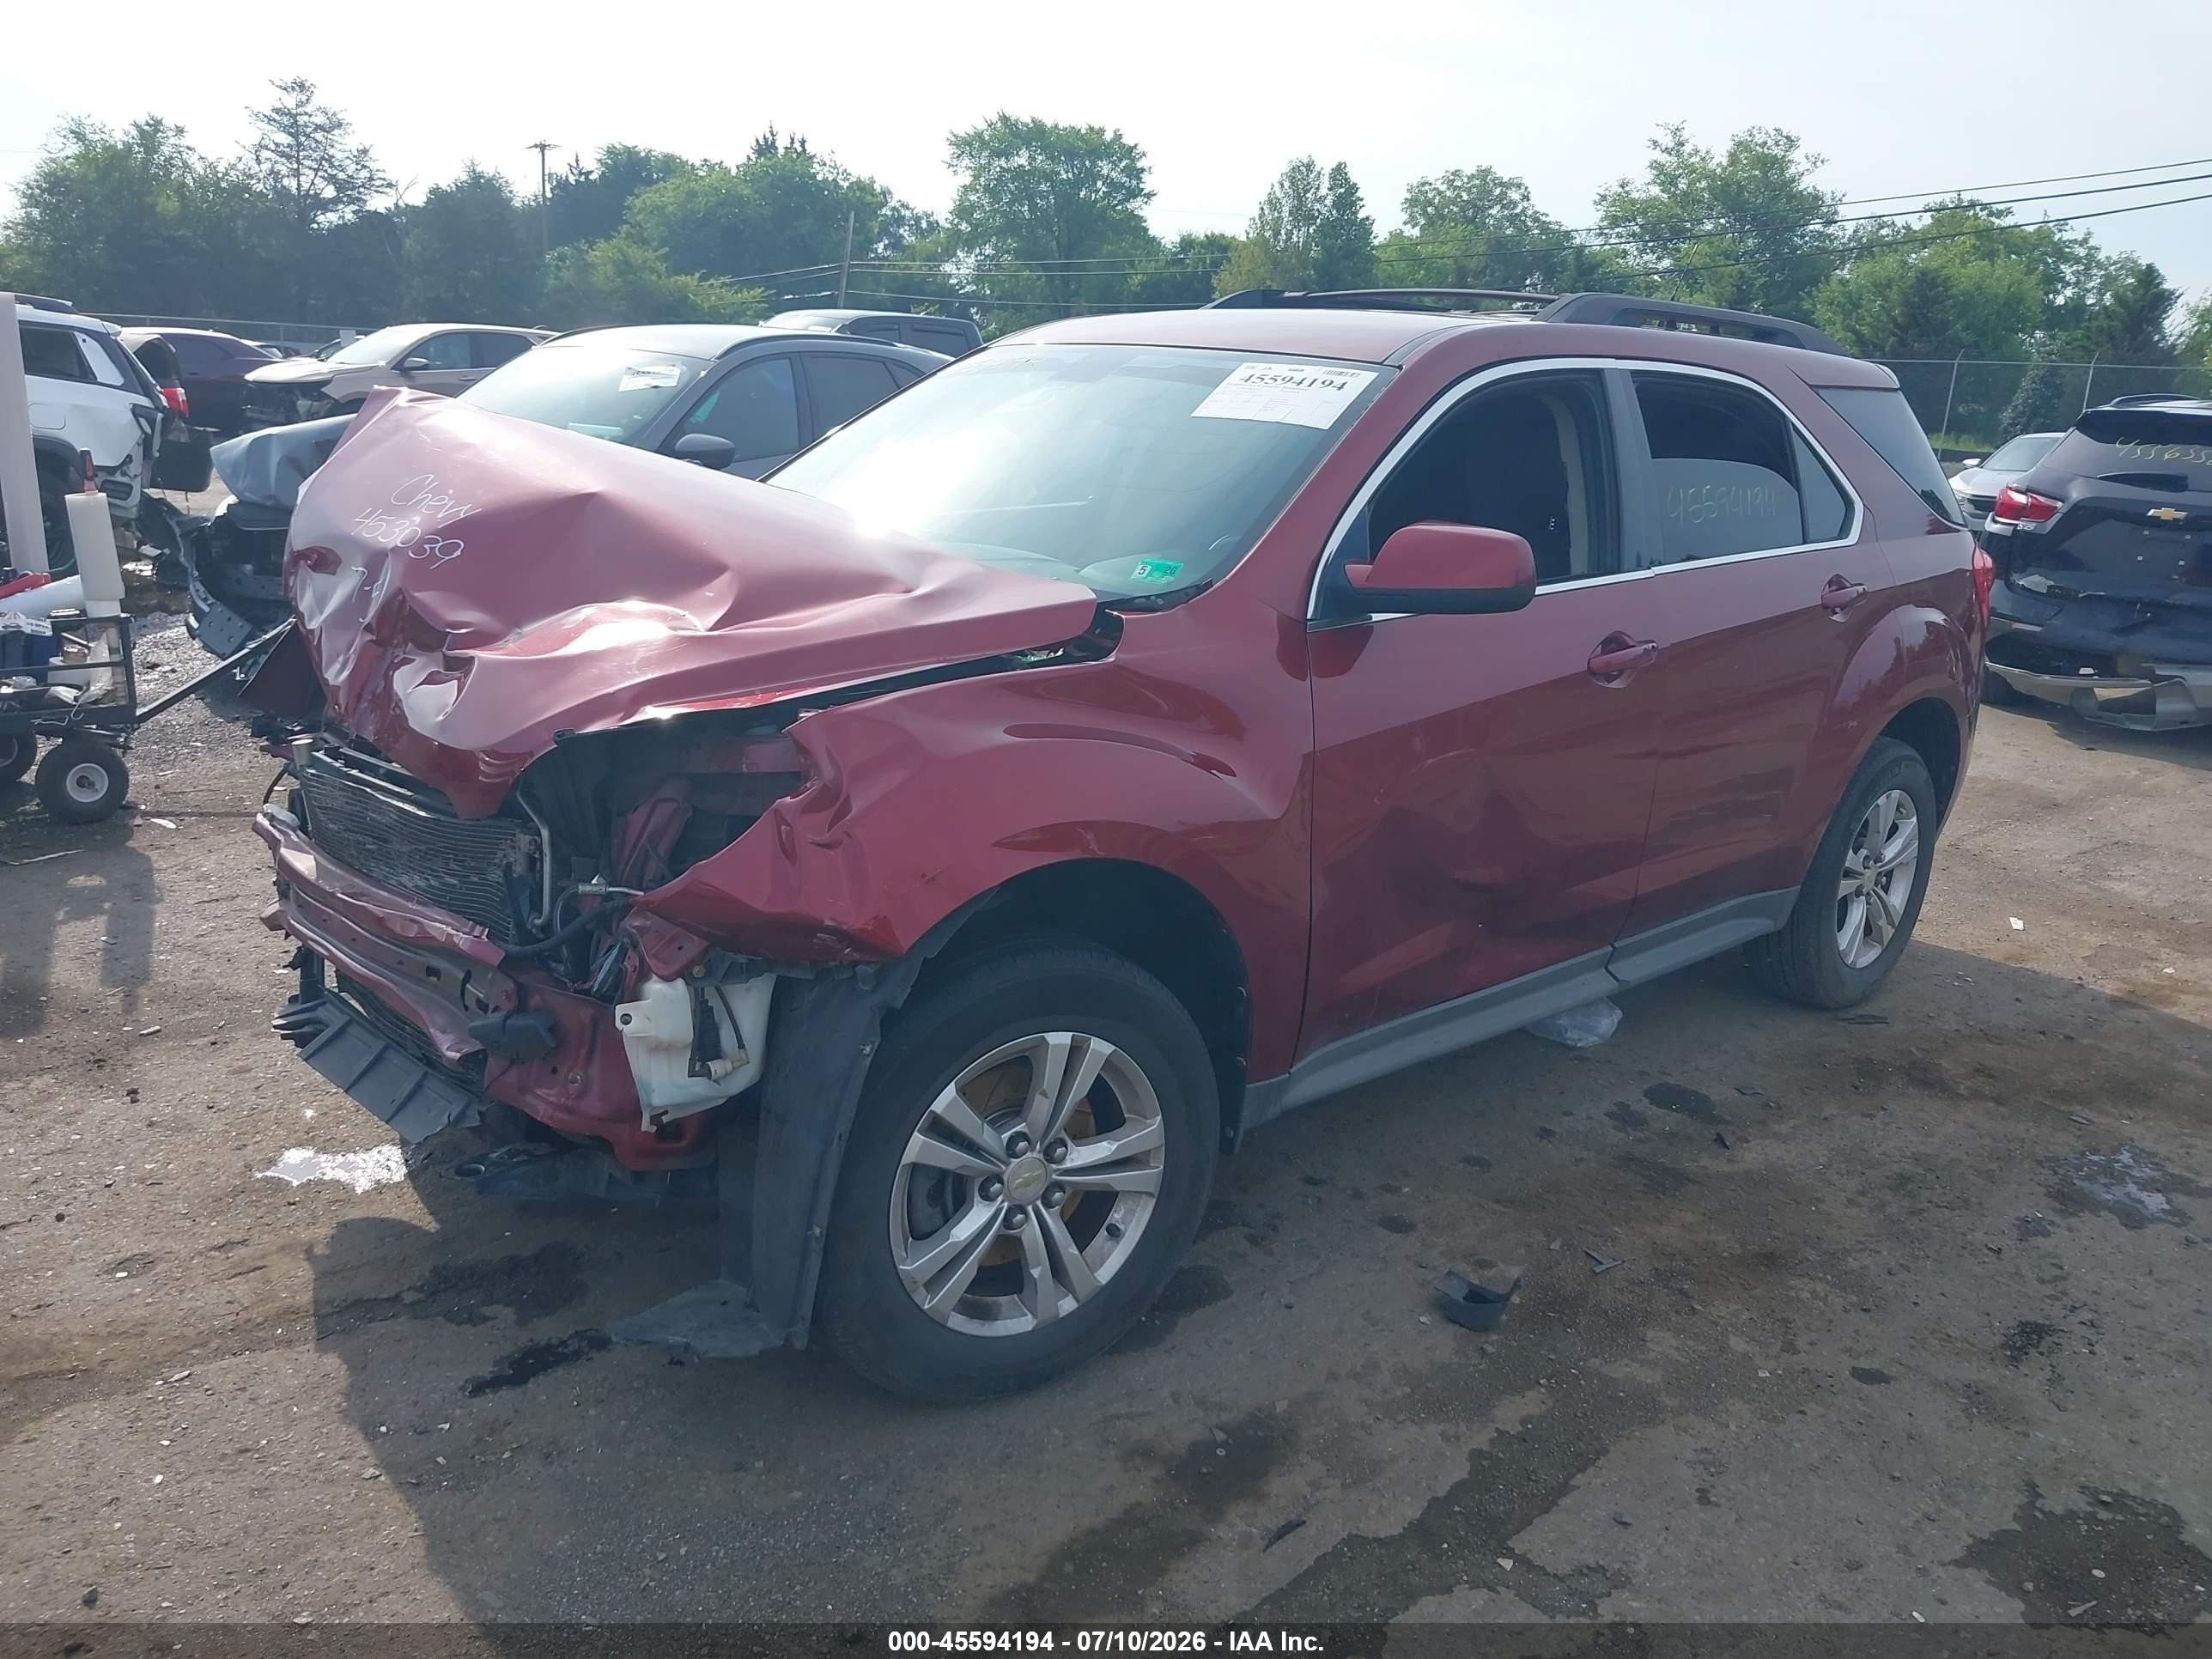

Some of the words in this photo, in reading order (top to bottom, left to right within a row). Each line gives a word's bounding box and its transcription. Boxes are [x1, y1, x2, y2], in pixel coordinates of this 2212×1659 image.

[1239, 374, 1348, 392] 45594194
[1667, 485, 1776, 523] 45594194
[1138, 566, 1148, 575] 5
